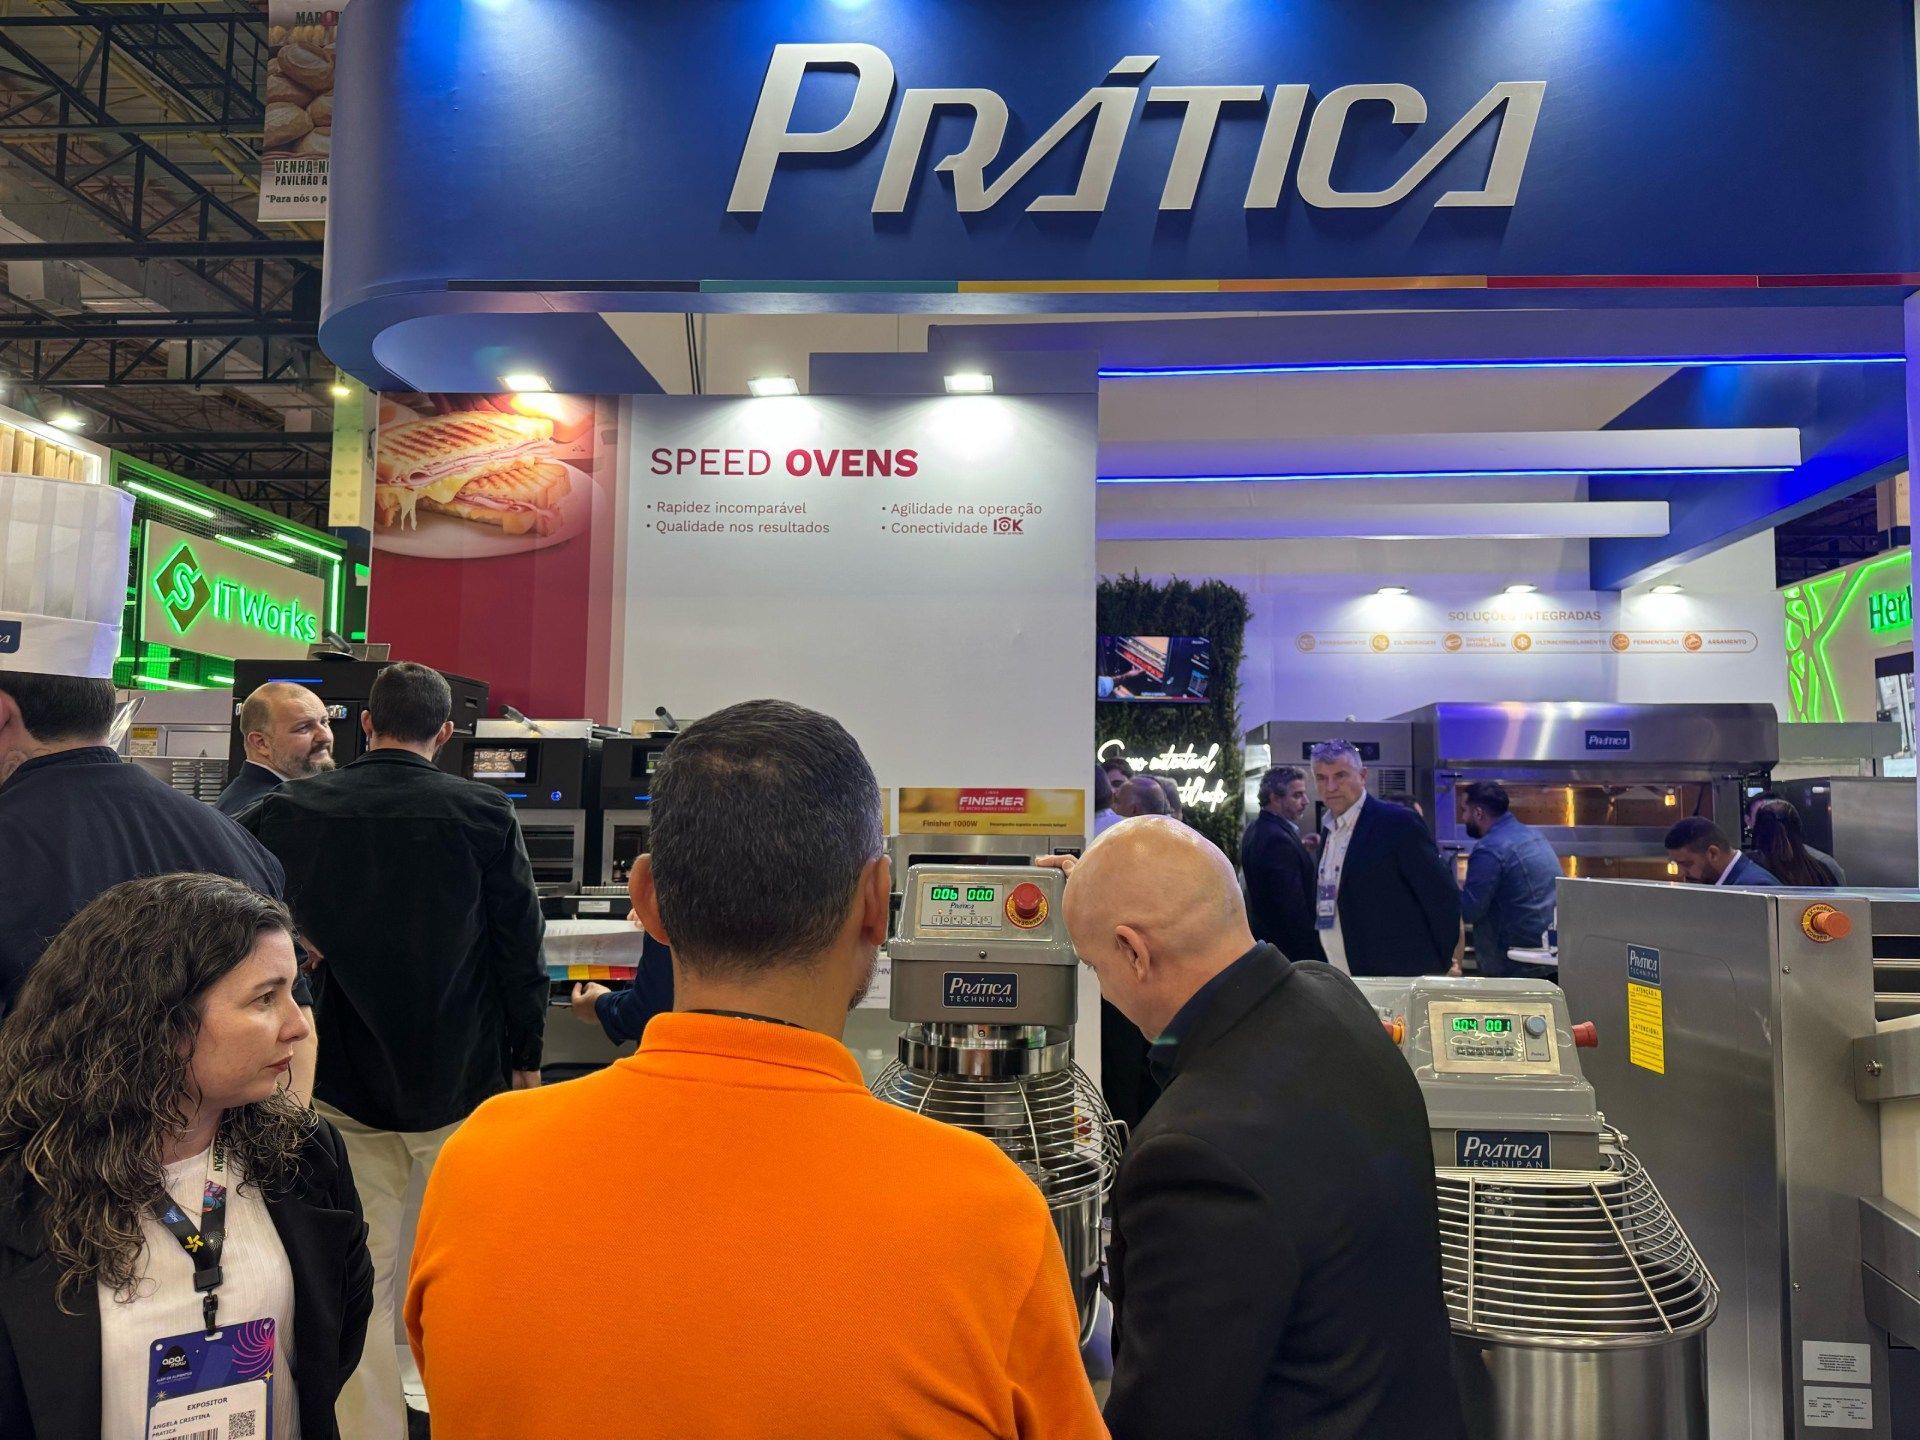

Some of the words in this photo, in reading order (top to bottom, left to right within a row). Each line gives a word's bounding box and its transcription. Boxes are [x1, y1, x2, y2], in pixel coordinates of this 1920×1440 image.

[726, 43, 1547, 213] PRÁTICA
[275, 160, 313, 173] VENHA
[275, 173, 318, 186] PAVILHÃO
[293, 194, 310, 203] nós
[312, 195, 318, 203] o
[650, 448, 771, 476] SPEED
[786, 449, 918, 477] OVENS
[656, 501, 711, 516] Rapidez
[715, 501, 807, 516] incomparável
[890, 503, 953, 517] Agilidade
[957, 505, 975, 515] na
[978, 503, 1042, 518] operação
[656, 520, 725, 534] Qualidade
[729, 523, 754, 534] nos
[758, 520, 830, 534] resultados
[891, 522, 988, 534] Conectividade
[959, 796, 1024, 806] FINISHER
[922, 819, 951, 828] Finisher
[954, 820, 978, 828] 1000W
[949, 977, 1012, 995] PRÁTICA
[949, 995, 1012, 1003] TECHNIPAN
[1464, 1136, 1542, 1159] PRÁTICA
[1464, 1159, 1543, 1168] TECHNIPAN
[187, 1397, 229, 1411] EXPOSITOR
[152, 1420, 179, 1431] ANGELA
[179, 1412, 212, 1425] CRISTINA
